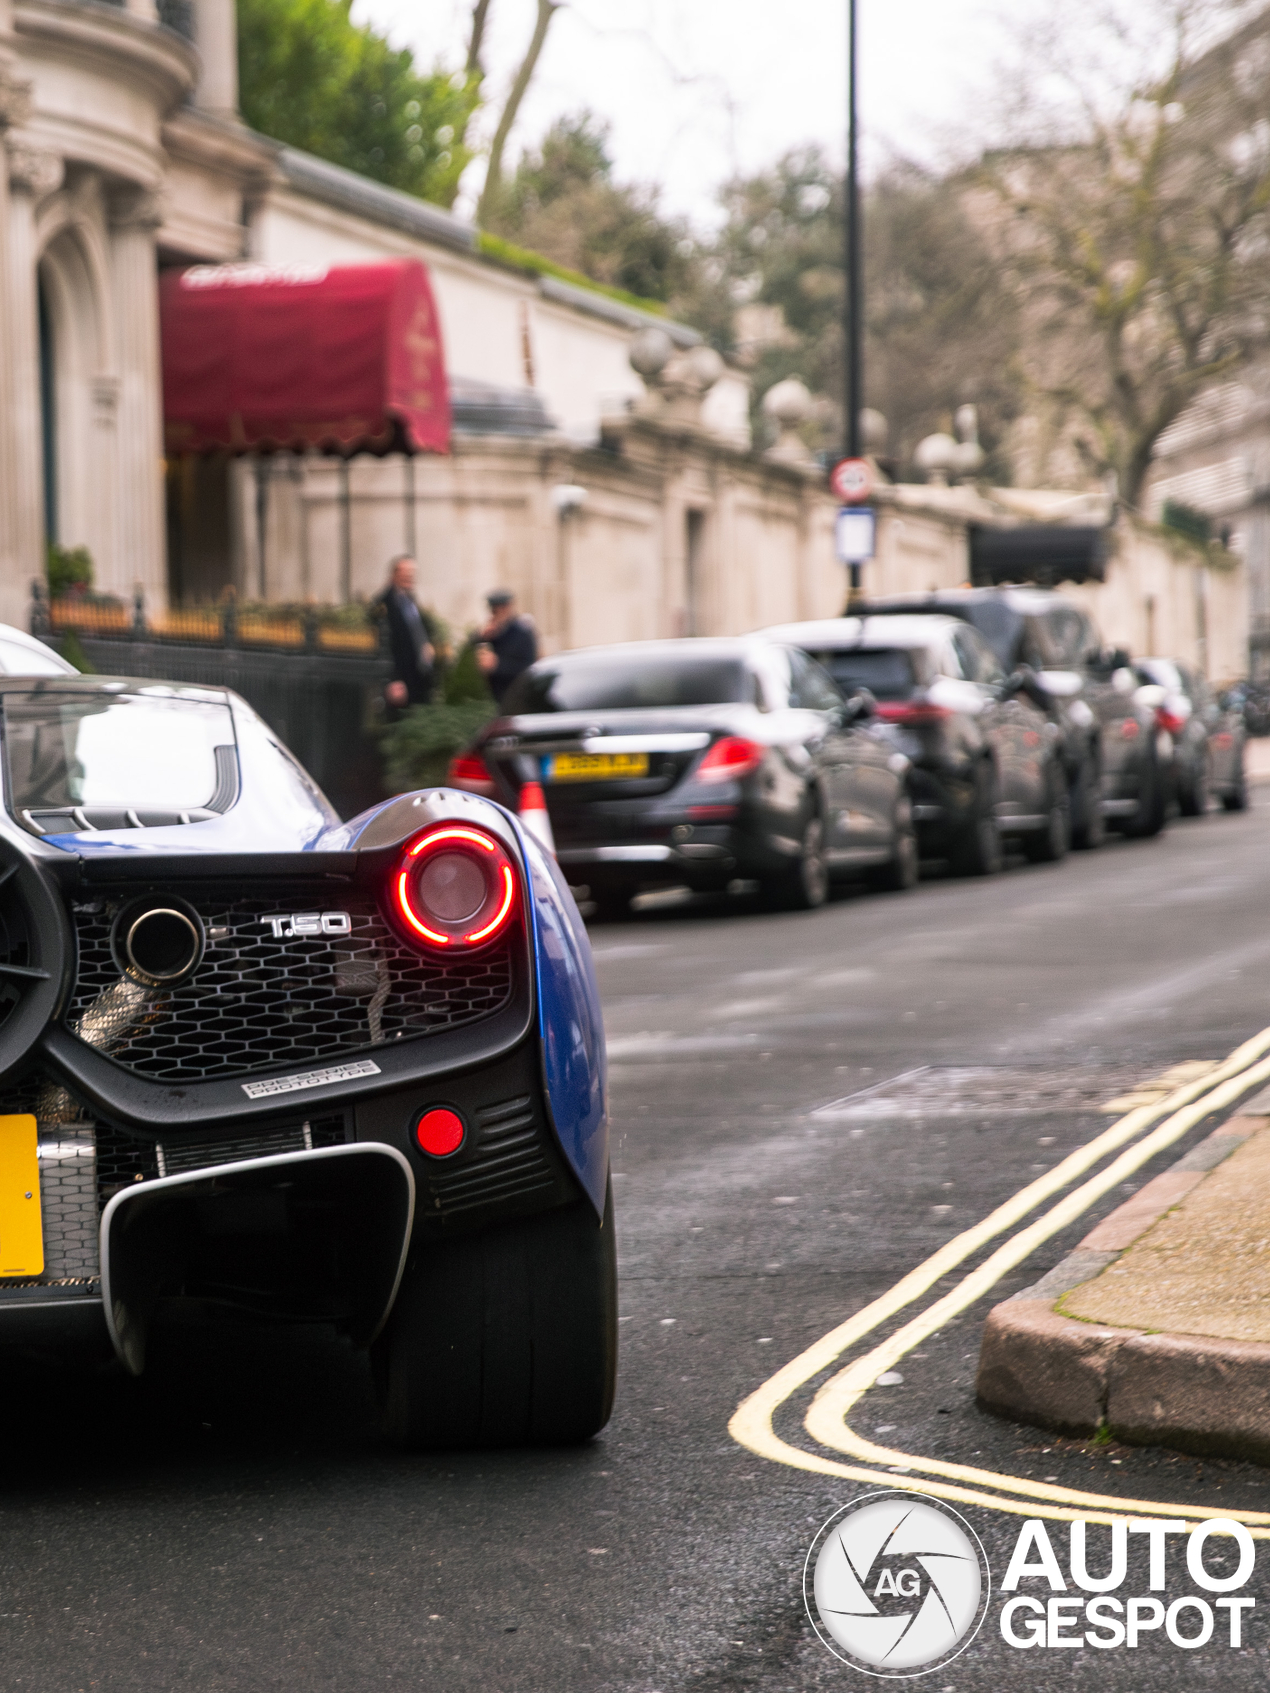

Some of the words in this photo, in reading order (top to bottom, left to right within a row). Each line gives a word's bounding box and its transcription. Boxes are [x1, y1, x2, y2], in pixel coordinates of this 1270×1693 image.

[260, 911, 352, 938] T.50
[247, 1060, 371, 1090] PRE-SERIES
[251, 1067, 376, 1095] PROTOTYPE
